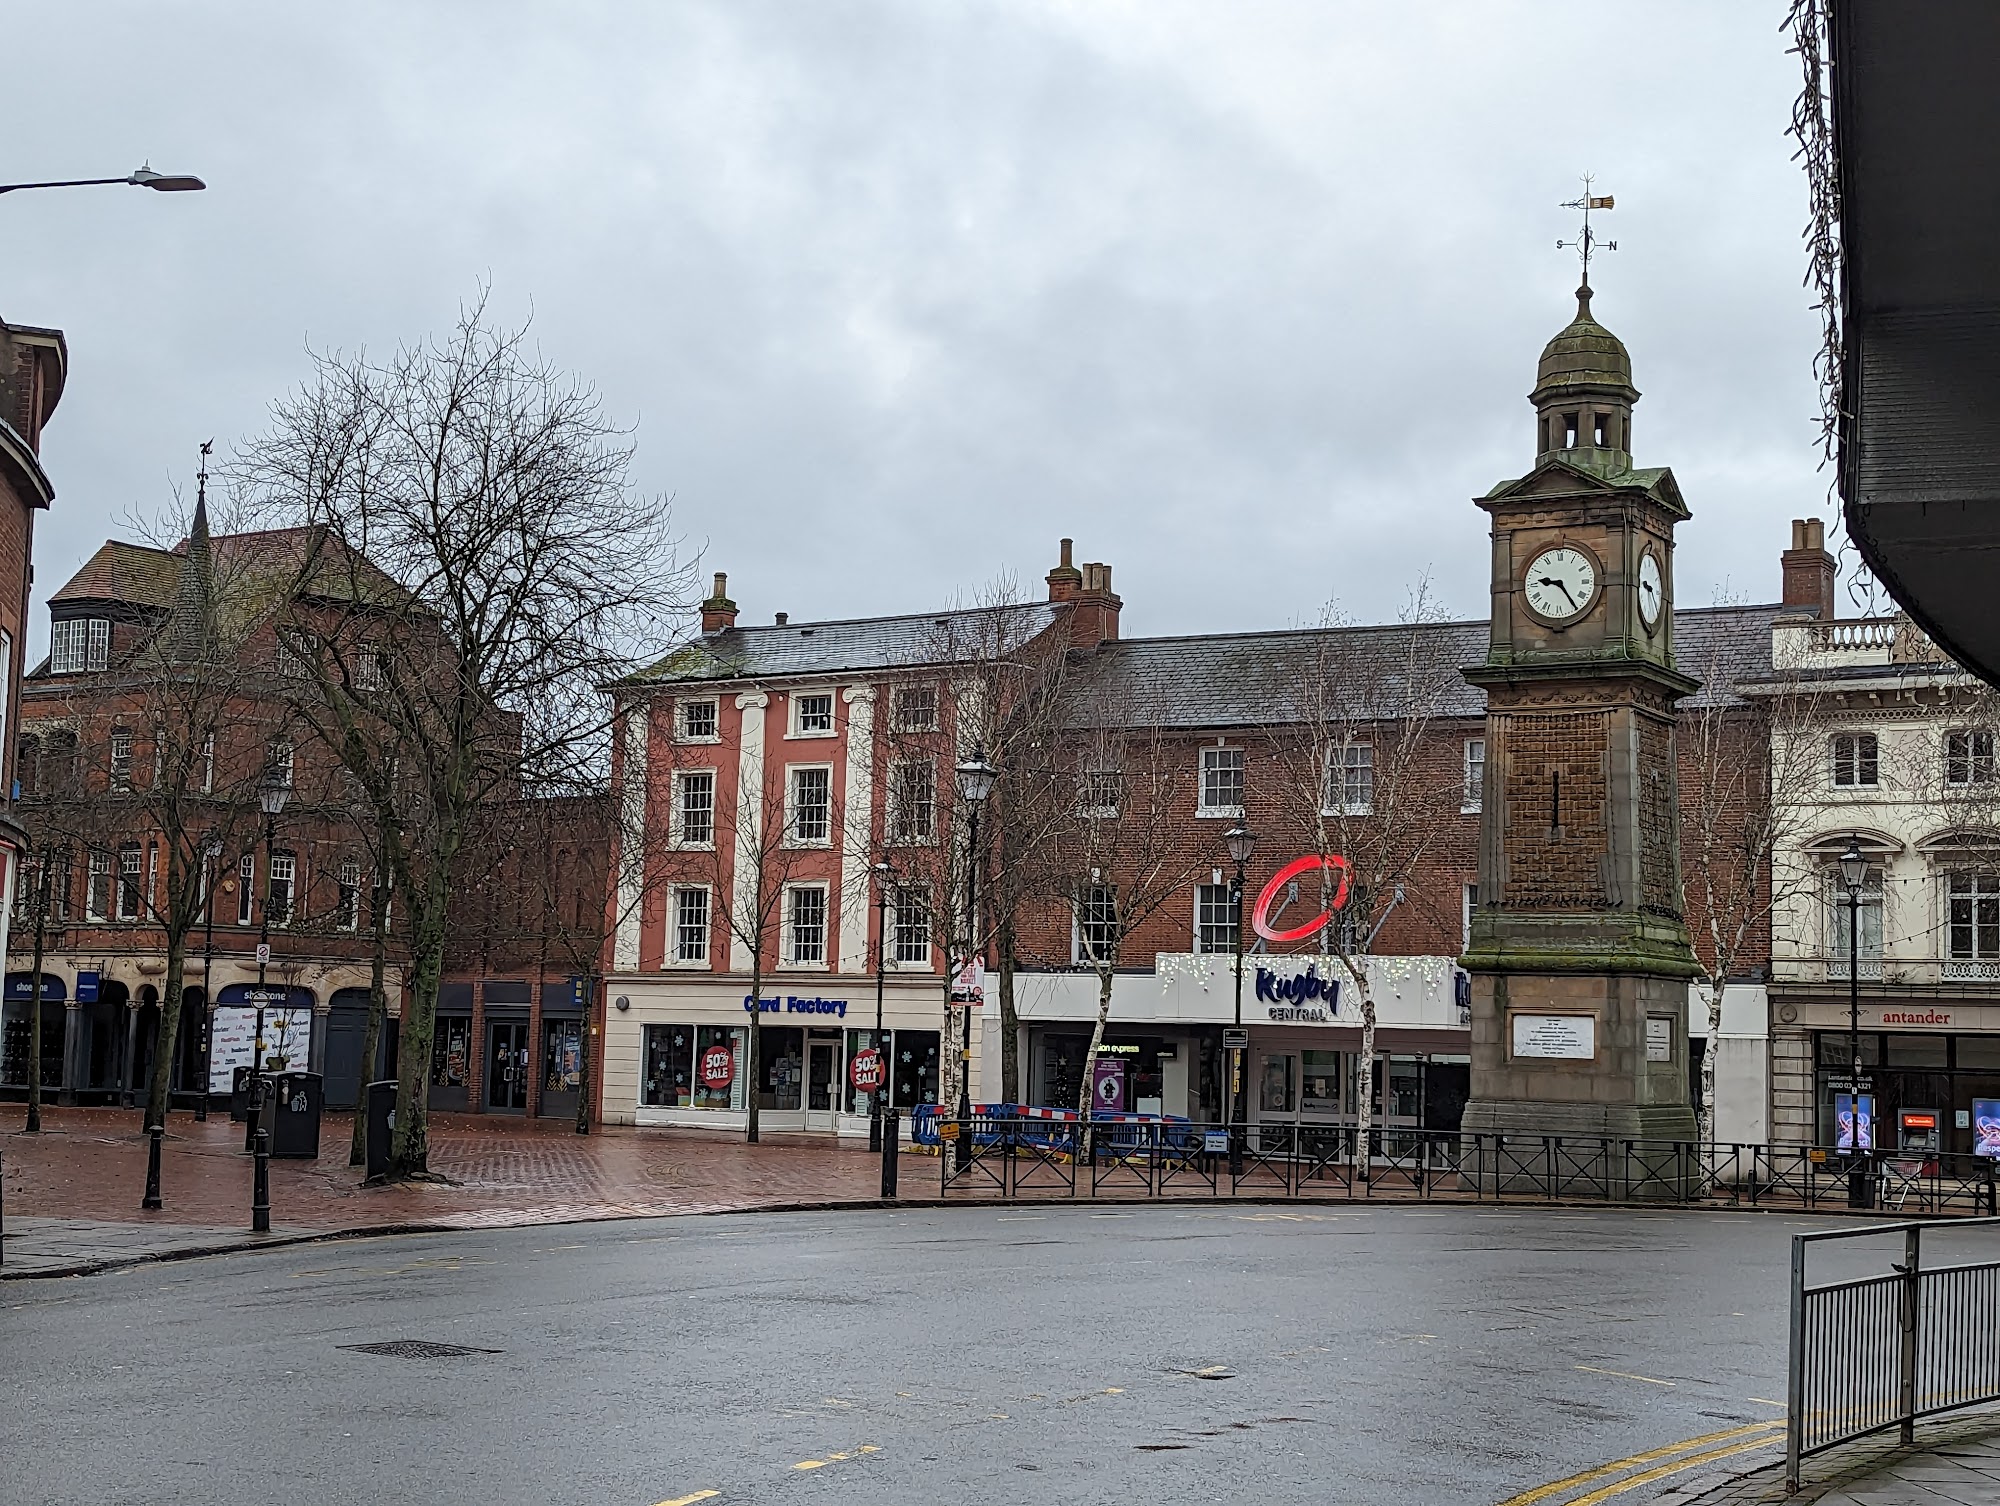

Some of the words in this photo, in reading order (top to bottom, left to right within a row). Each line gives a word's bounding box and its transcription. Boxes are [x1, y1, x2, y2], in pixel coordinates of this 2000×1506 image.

[1556, 239, 1563, 249] S
[1609, 240, 1617, 251] N
[16, 982, 49, 992] shoene
[1255, 961, 1340, 1017] Rugby
[787, 996, 848, 1018] Factory
[1268, 1007, 1327, 1023] CENTRAL
[1883, 1008, 1951, 1025] antander
[706, 1068, 729, 1080] SALE
